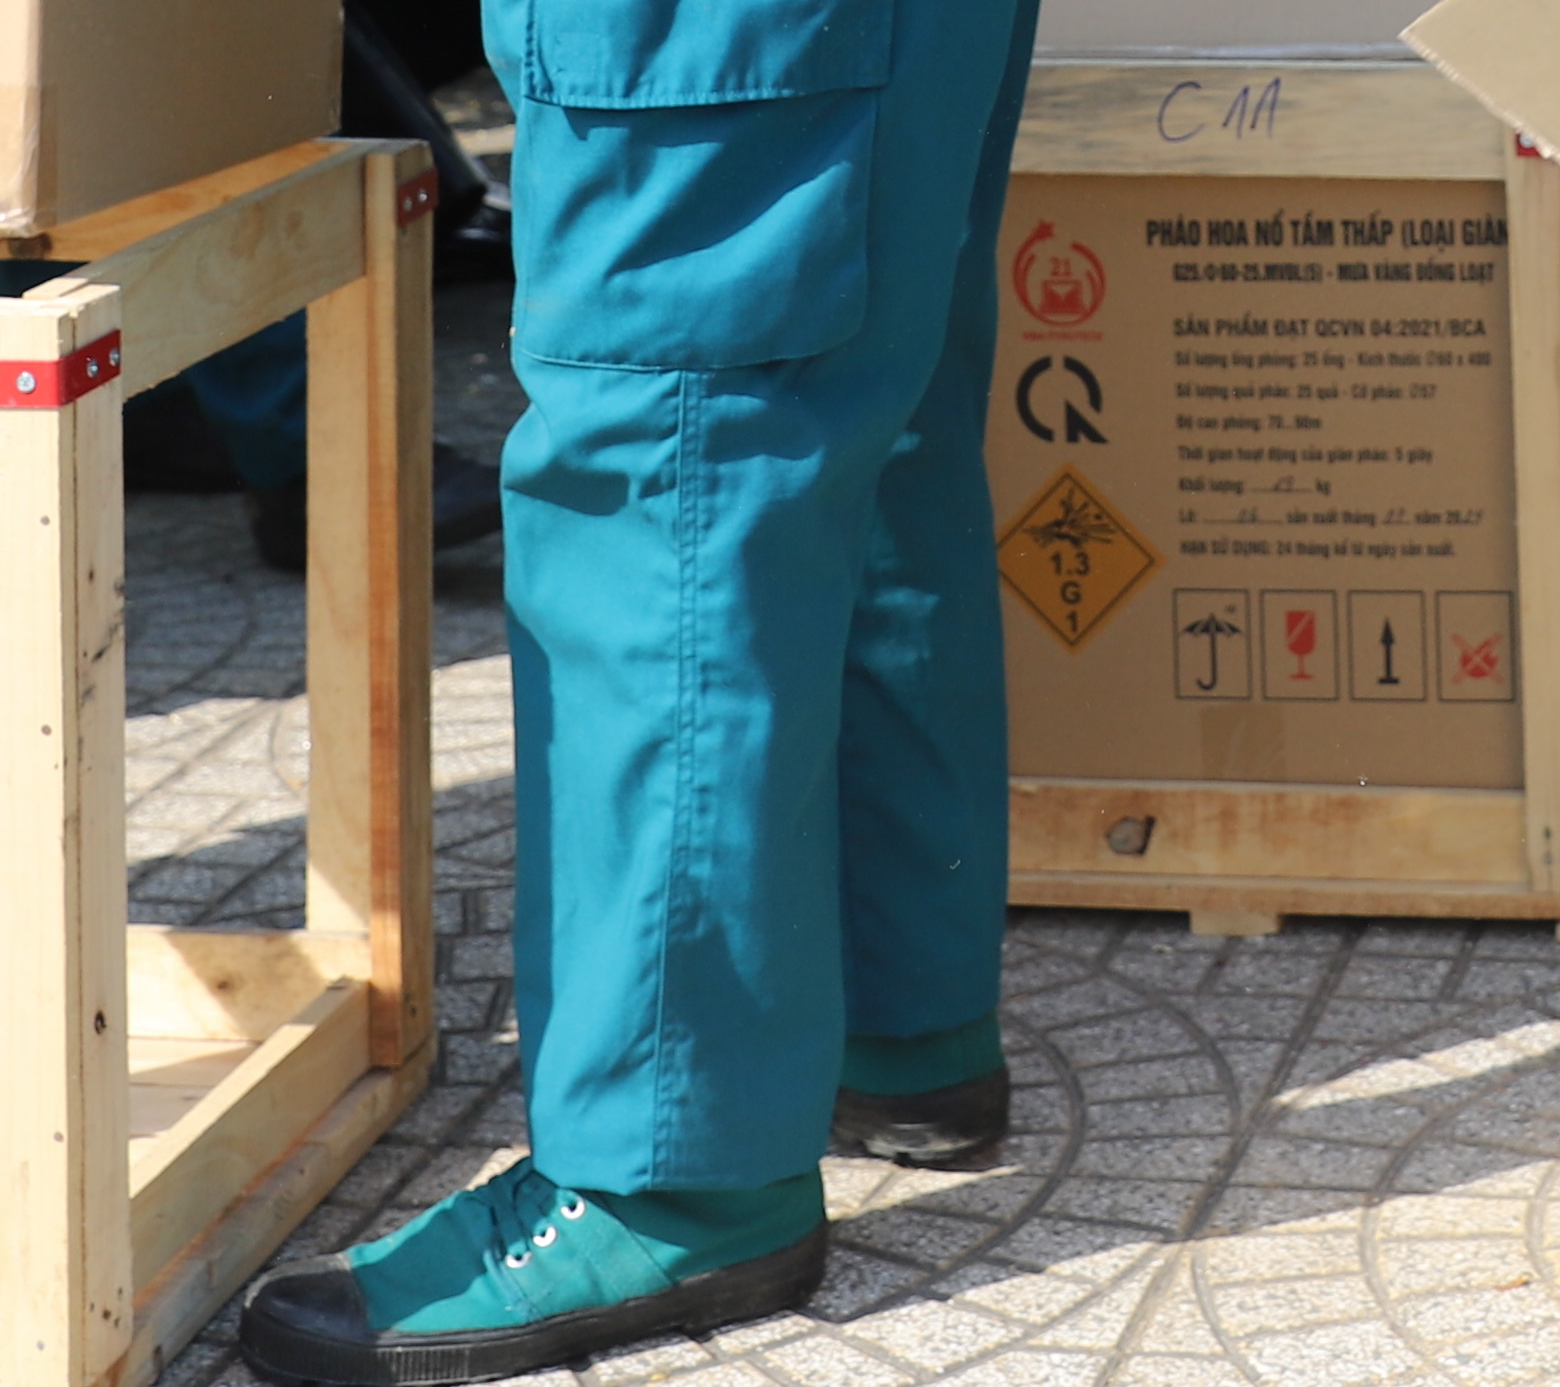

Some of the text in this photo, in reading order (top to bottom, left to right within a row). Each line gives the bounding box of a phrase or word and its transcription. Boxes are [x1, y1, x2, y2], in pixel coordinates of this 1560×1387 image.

[1049, 551, 1091, 578] 1.3
[1061, 580, 1082, 606] G
[1066, 610, 1078, 633] 1
